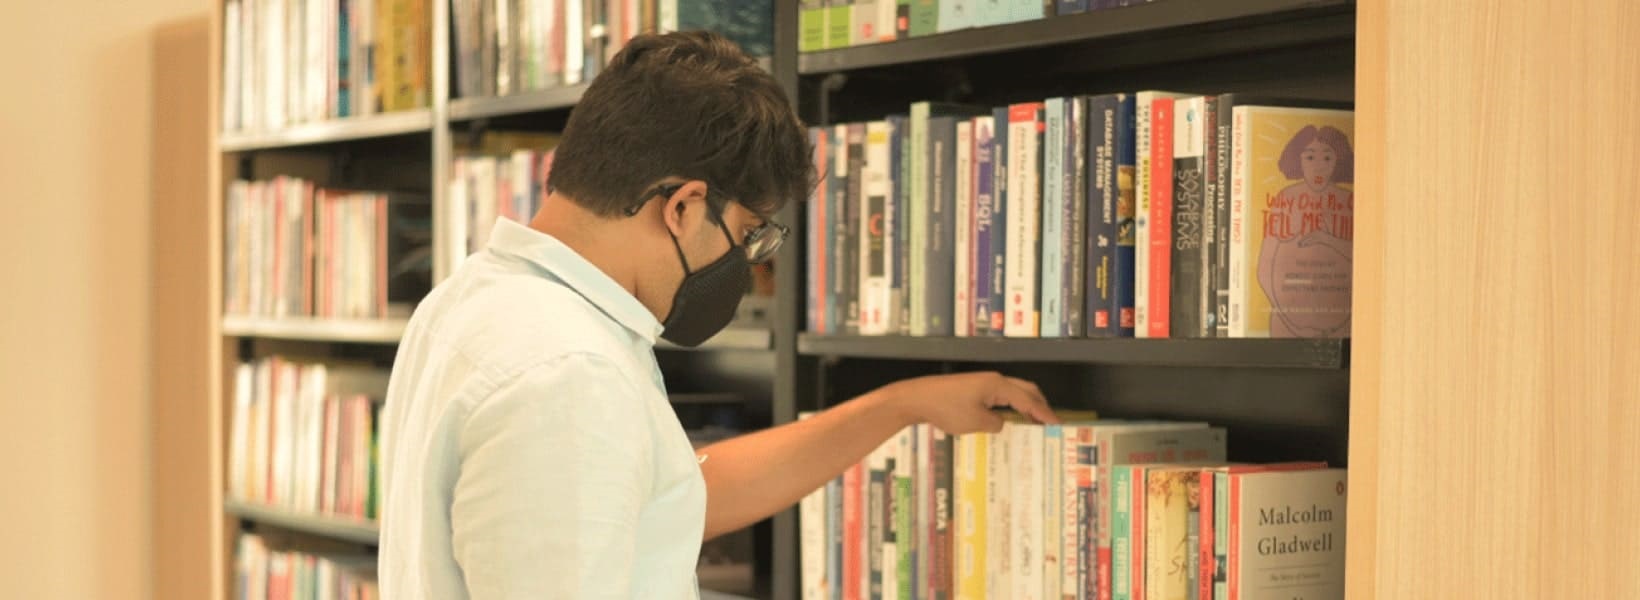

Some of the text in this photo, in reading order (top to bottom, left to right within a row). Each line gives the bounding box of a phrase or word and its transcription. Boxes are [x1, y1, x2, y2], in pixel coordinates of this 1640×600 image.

[1095, 146, 1104, 190] SYSTEMS
[1103, 109, 1113, 224] DATABASE MANAGEMENT
[1218, 126, 1226, 210] PHILOSOPHY
[977, 194, 992, 232] SQL
[1017, 174, 1026, 222] Complete
[1176, 168, 1190, 250] SYSTEMS
[1190, 168, 1200, 249] DATABASE
[1206, 184, 1216, 244] Processing
[1266, 193, 1295, 213] Why
[1299, 193, 1323, 208] Did
[1261, 210, 1295, 239] TELL
[1300, 211, 1323, 232] ME
[1017, 226, 1025, 278] Reference
[936, 488, 948, 531] DATA
[1066, 488, 1076, 526] AND
[1258, 503, 1334, 526] Malcolm
[1066, 533, 1076, 578] FURY
[1257, 533, 1334, 556] Gladwell
